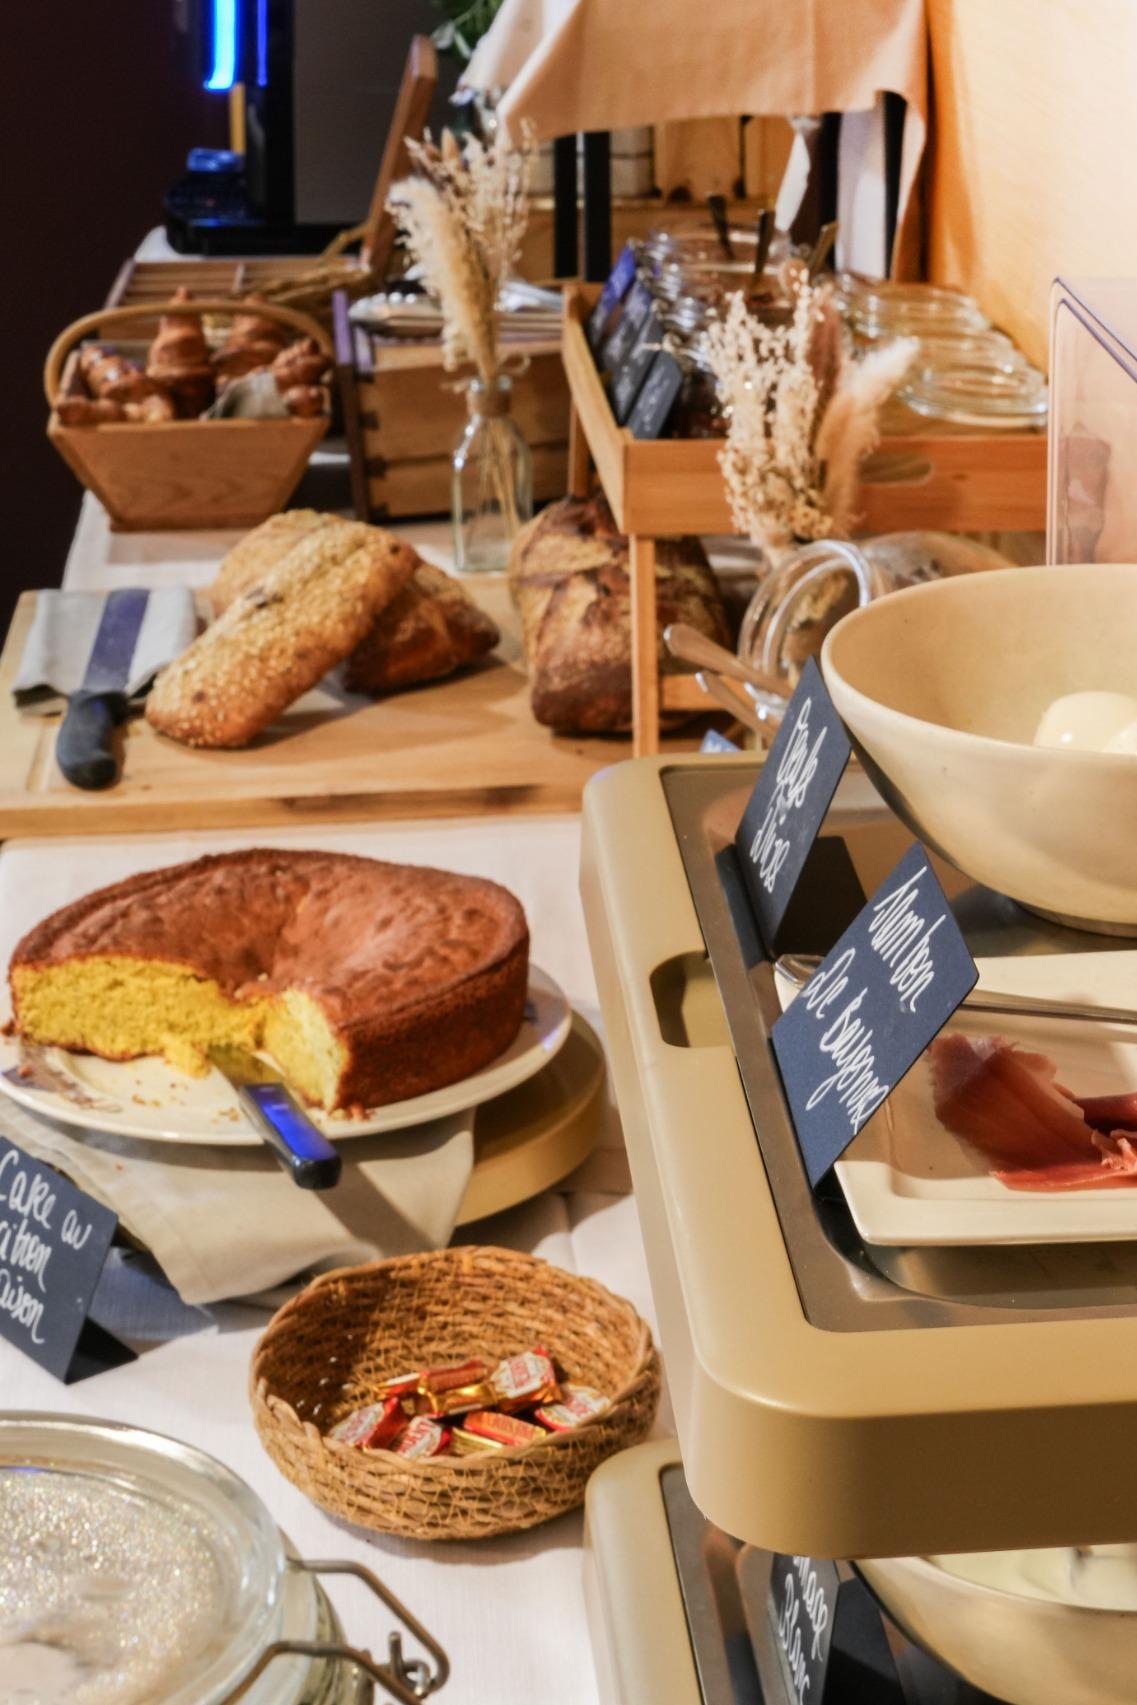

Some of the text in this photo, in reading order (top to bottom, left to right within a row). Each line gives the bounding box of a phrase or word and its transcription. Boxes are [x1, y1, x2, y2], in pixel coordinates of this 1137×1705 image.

[867, 865, 947, 1013] Jambon
[0, 1149, 92, 1250] Cake au
[0, 1268, 45, 1345] aison
